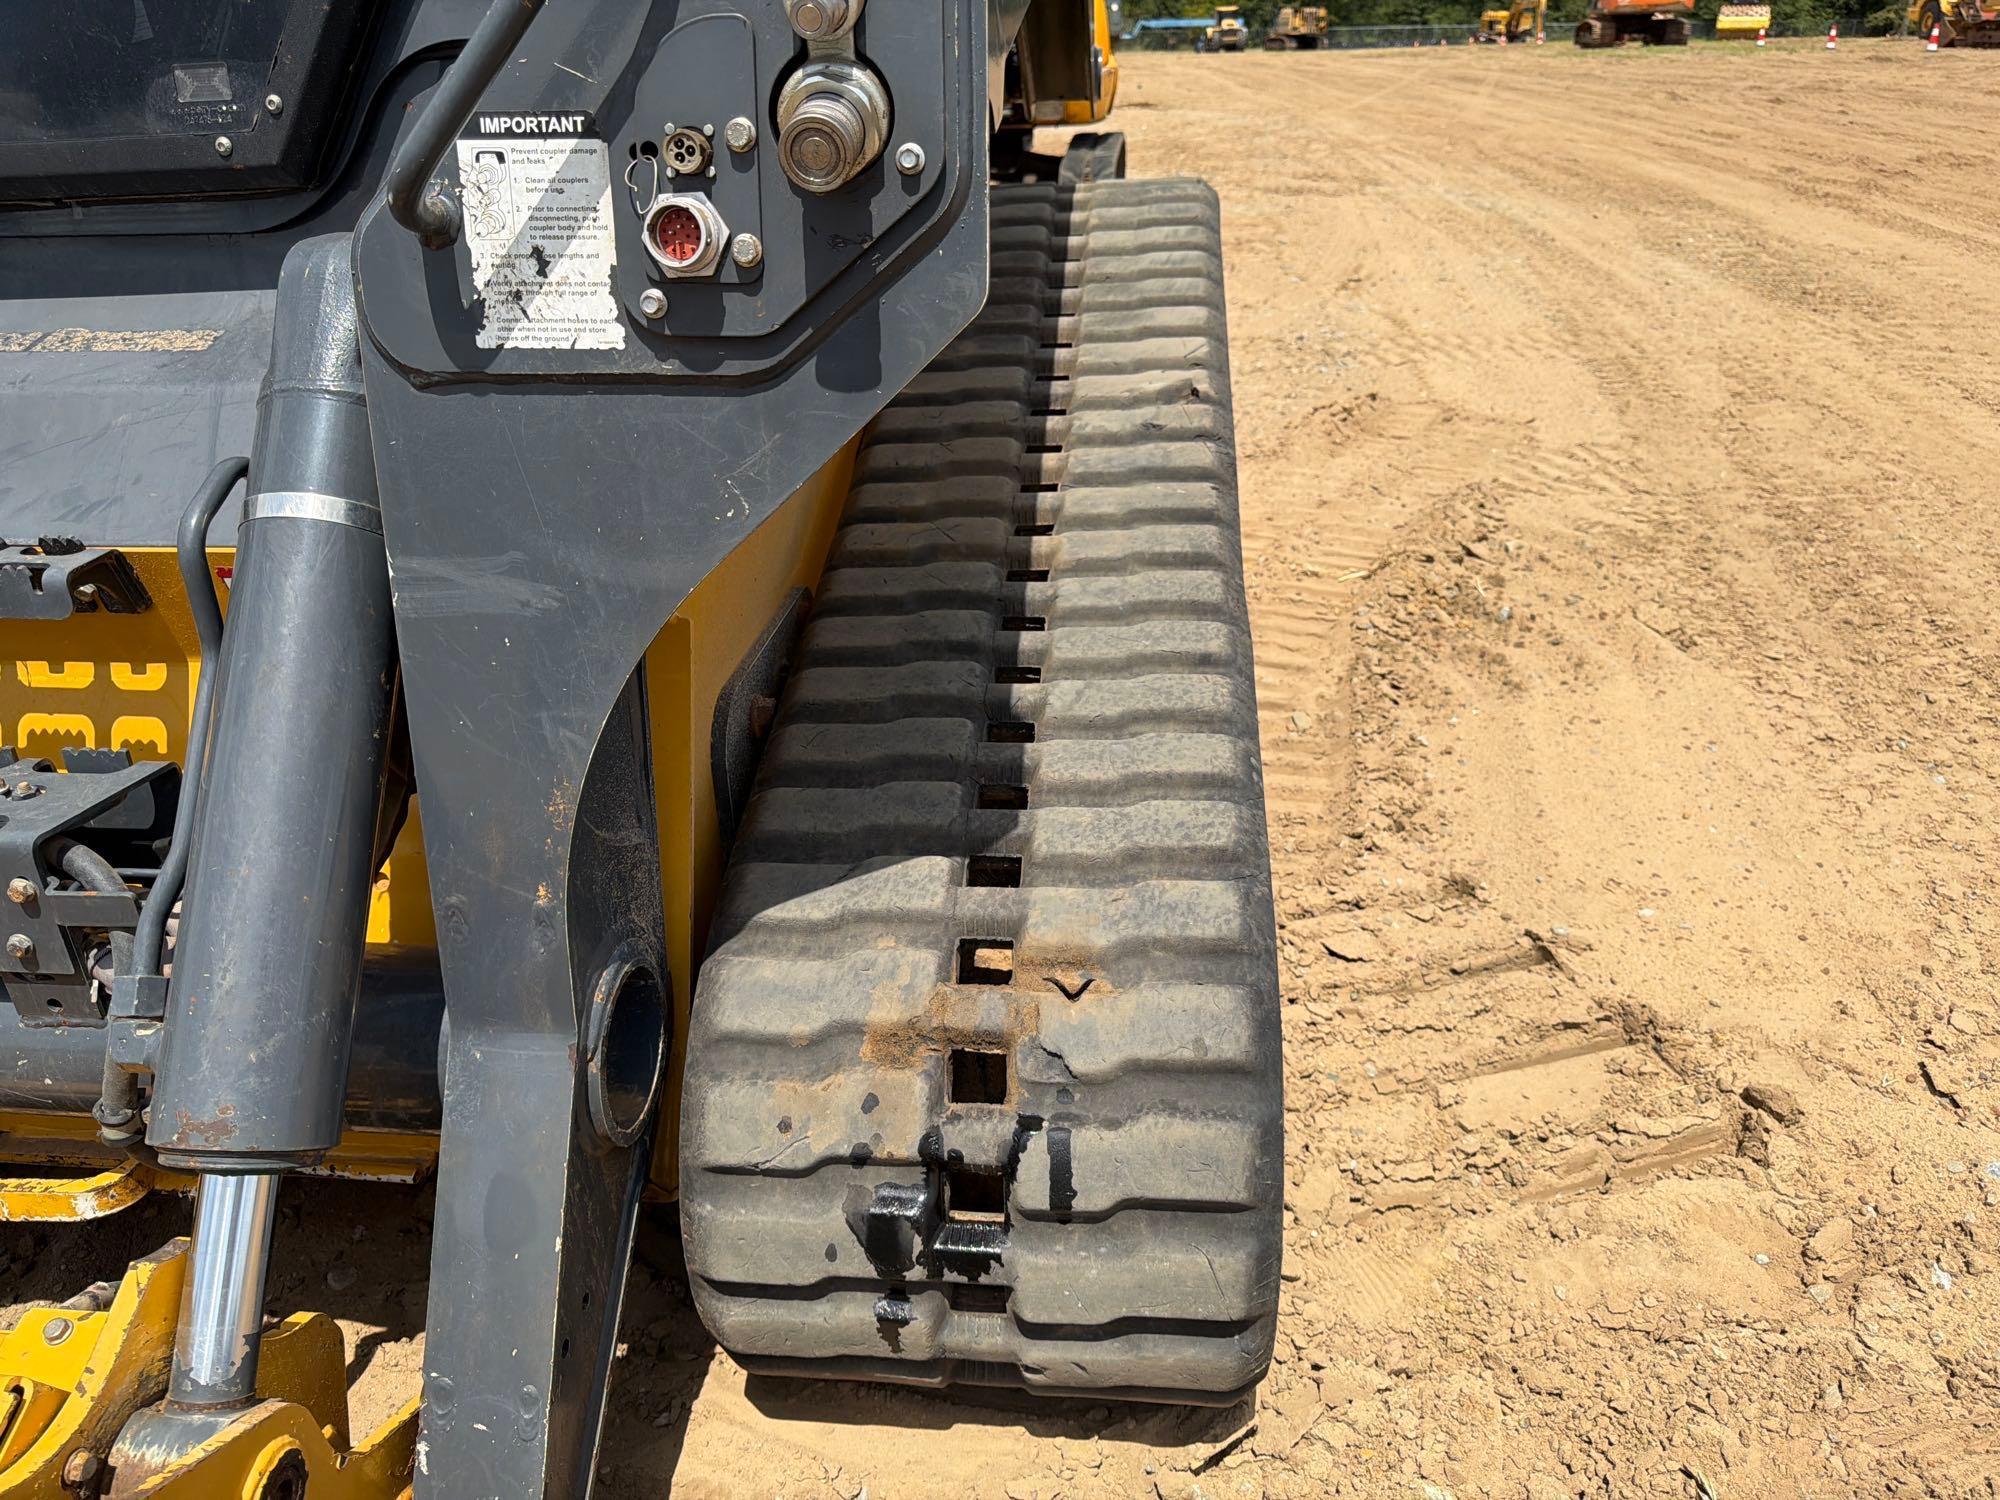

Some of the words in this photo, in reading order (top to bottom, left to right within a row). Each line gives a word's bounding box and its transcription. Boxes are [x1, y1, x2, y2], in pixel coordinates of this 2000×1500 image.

[480, 116, 585, 133] IMPORTANT
[540, 148, 567, 156] coupler
[557, 177, 588, 185] couplers
